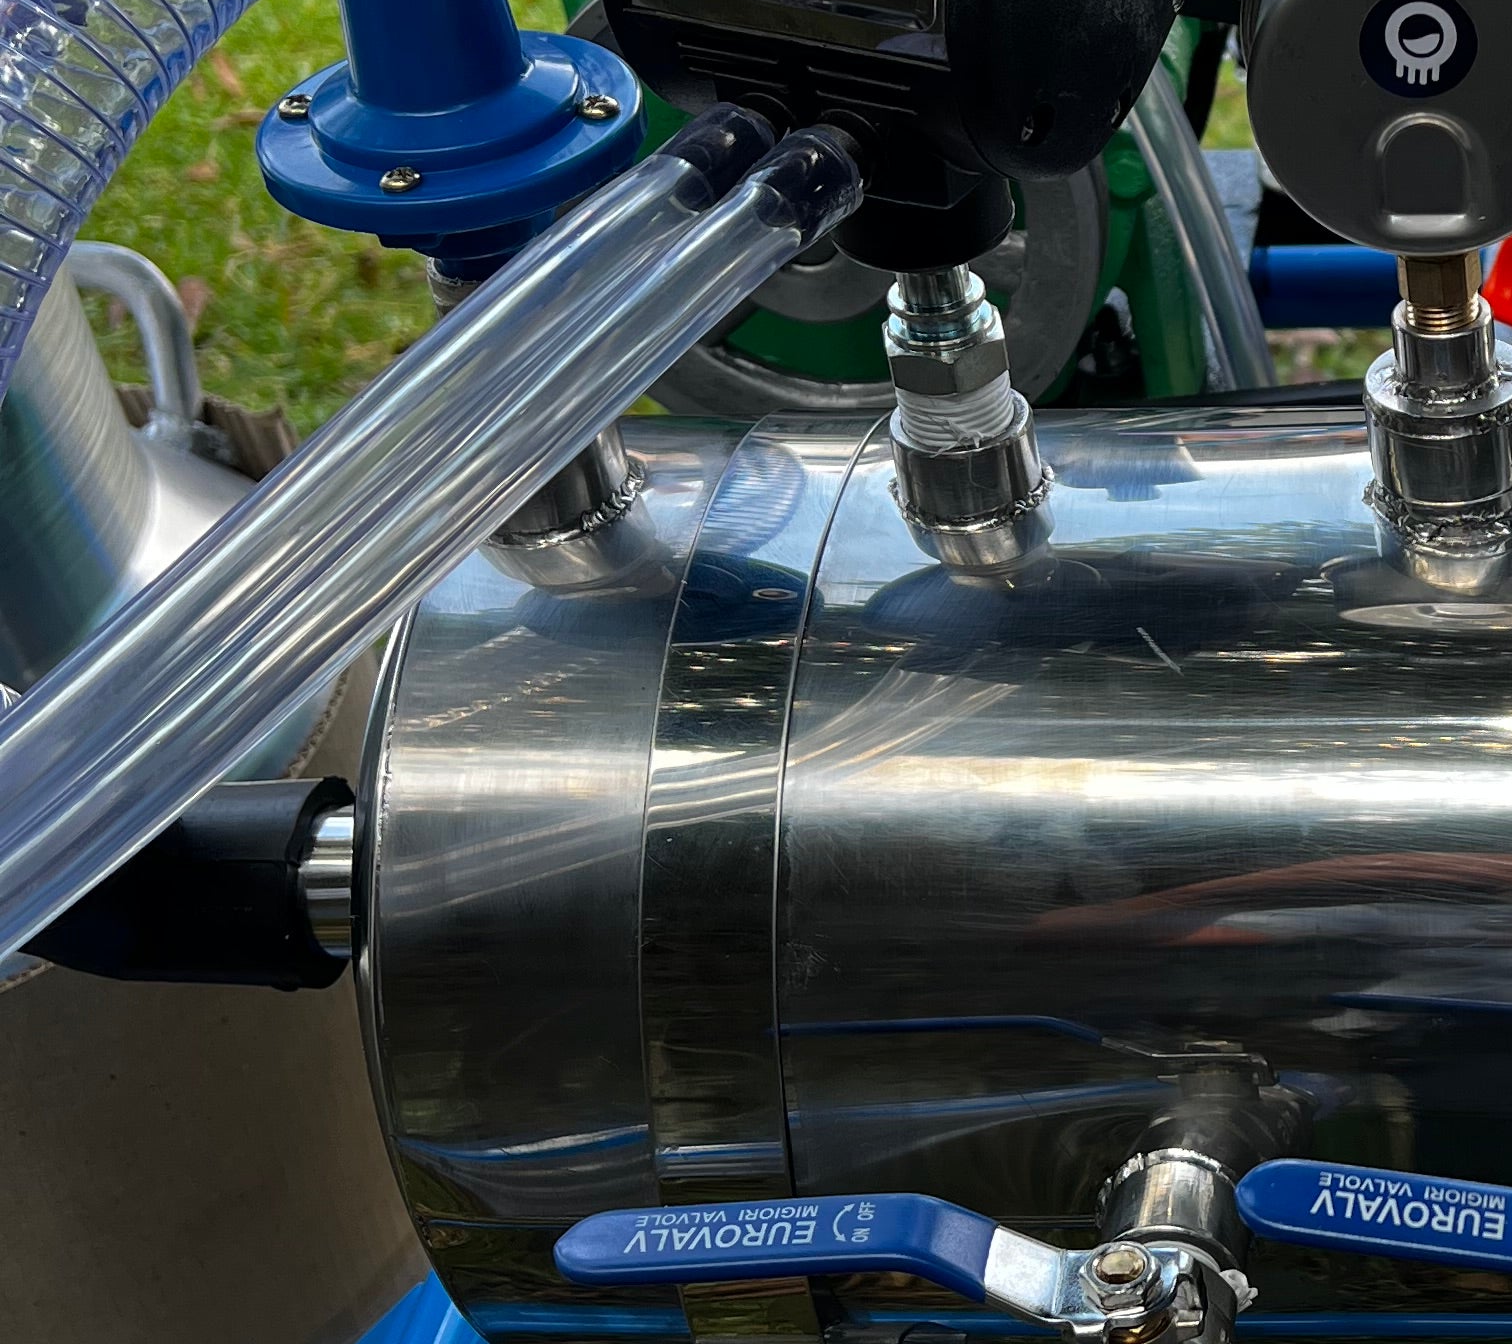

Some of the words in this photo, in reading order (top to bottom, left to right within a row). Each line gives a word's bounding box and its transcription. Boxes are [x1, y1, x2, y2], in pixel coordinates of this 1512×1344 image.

[1318, 1171, 1413, 1198] VALVOLE
[1423, 1184, 1506, 1210] MIGIORI
[634, 1209, 728, 1227] VALVOLE
[738, 1204, 819, 1222] MIGIORI
[857, 1201, 875, 1222] OFF
[1310, 1189, 1505, 1240] EUROVALV
[623, 1221, 817, 1253] EUROVALV
[852, 1226, 870, 1243] ON
